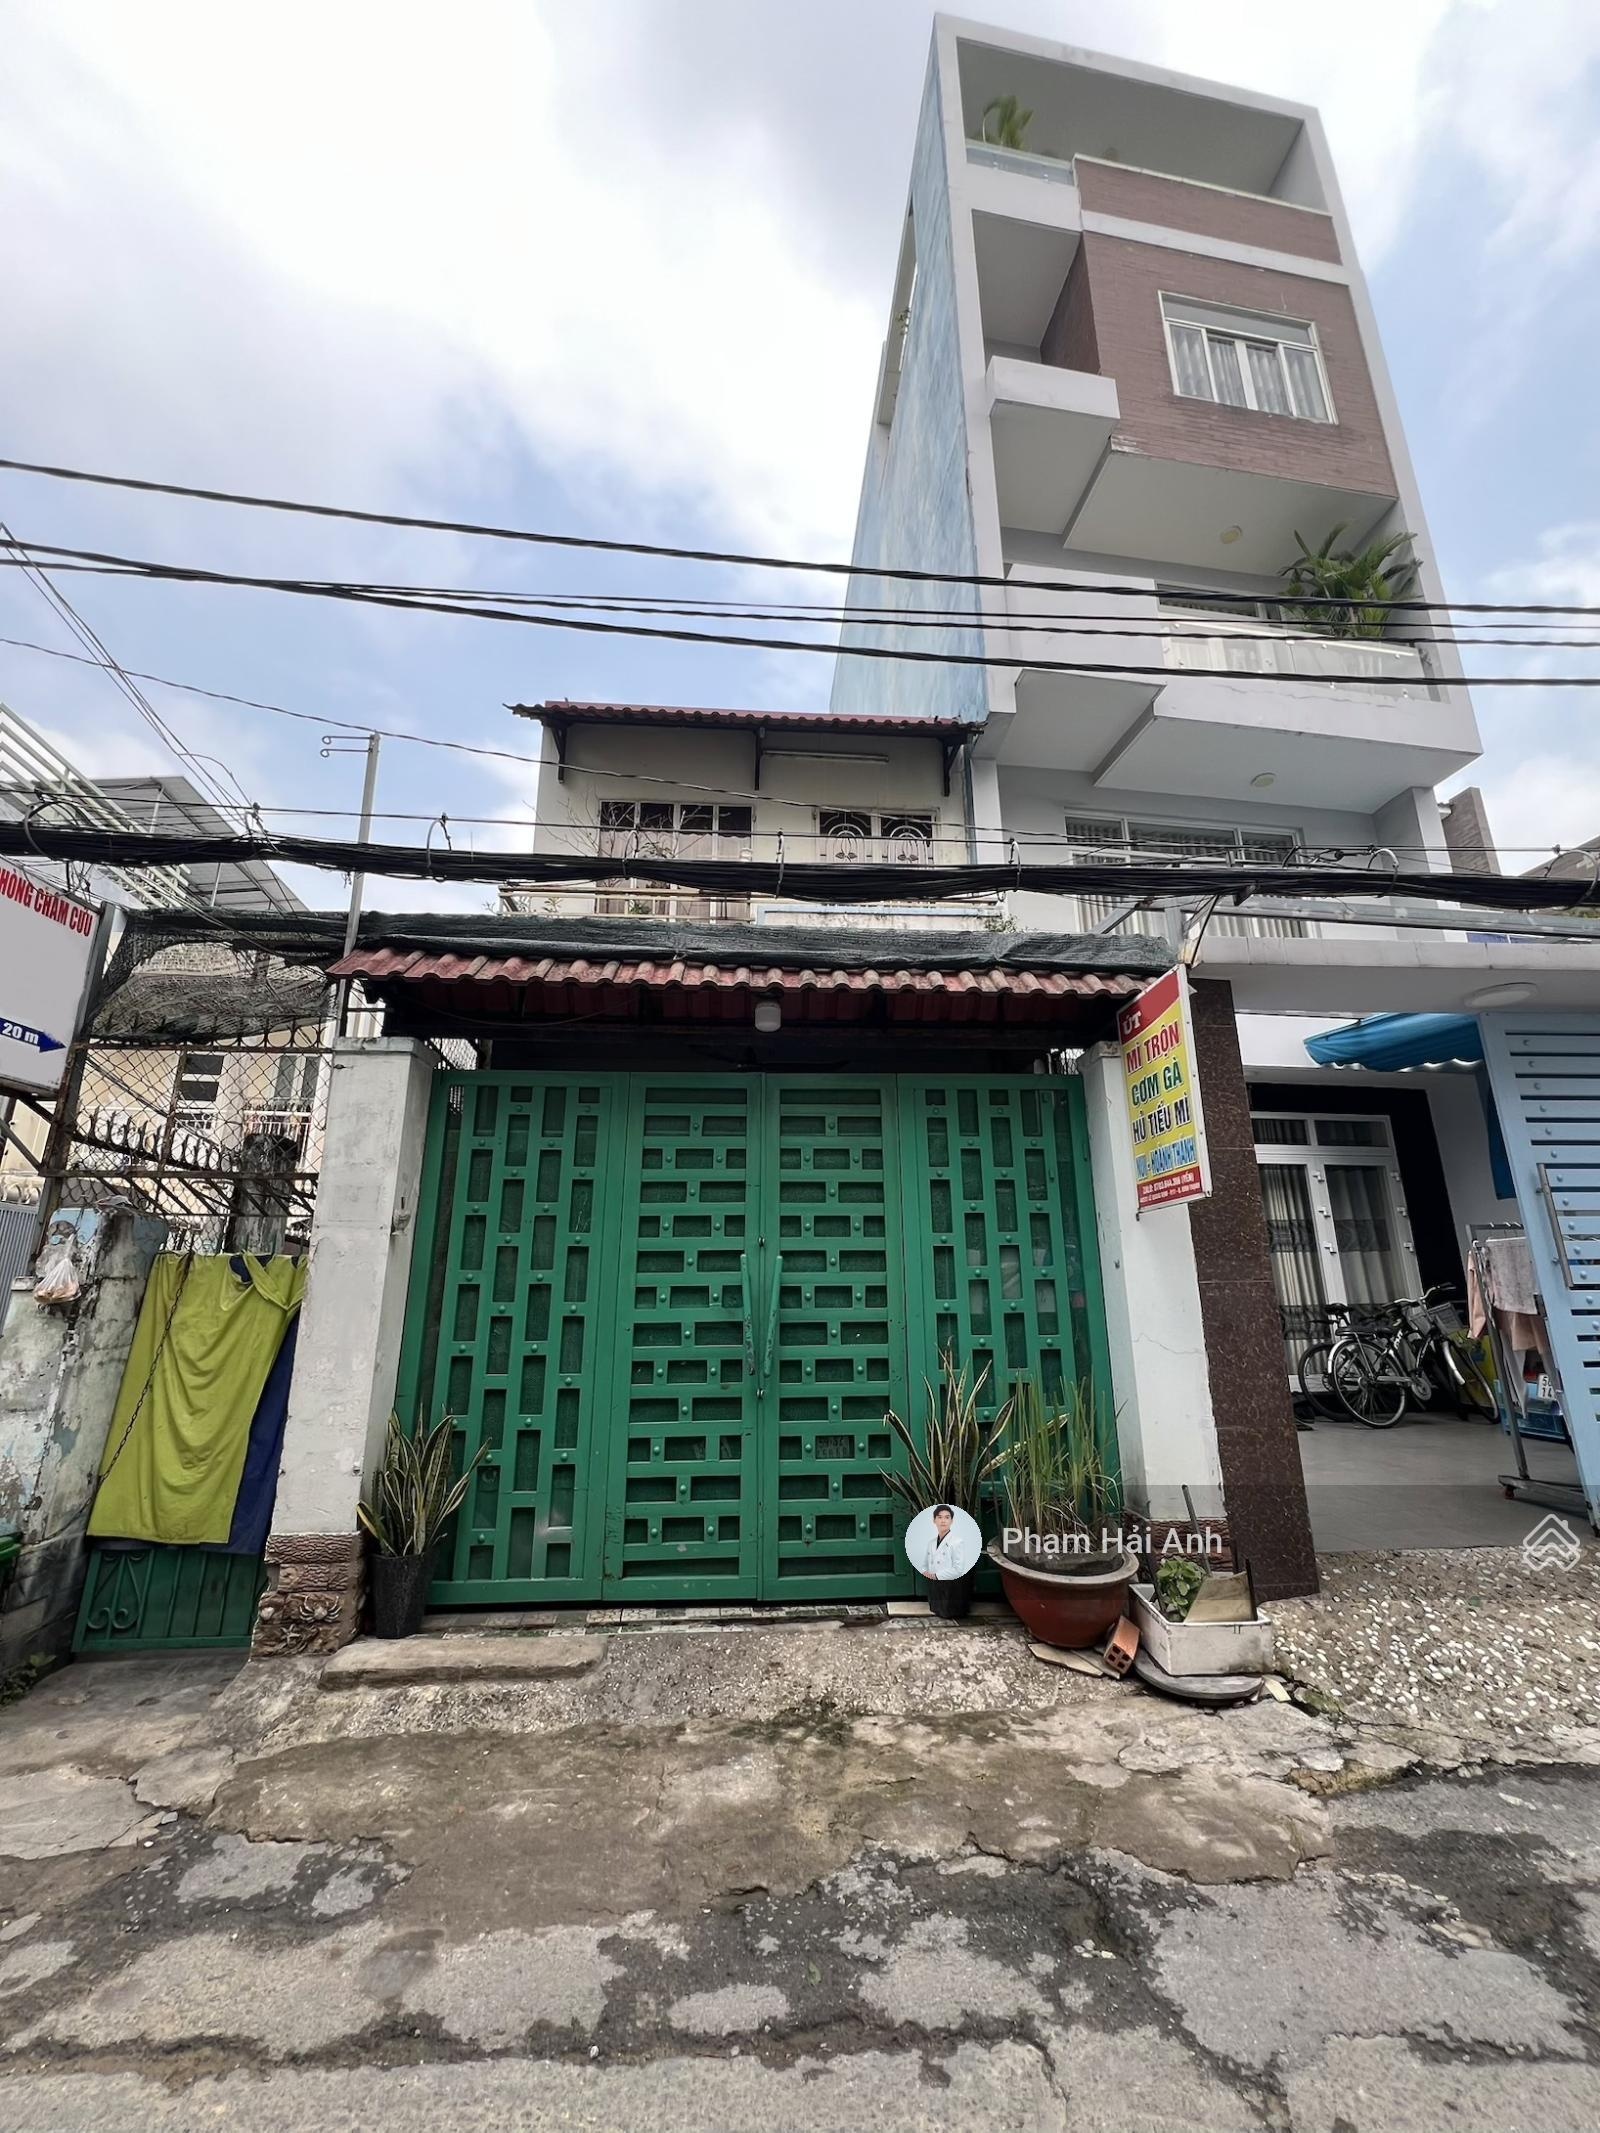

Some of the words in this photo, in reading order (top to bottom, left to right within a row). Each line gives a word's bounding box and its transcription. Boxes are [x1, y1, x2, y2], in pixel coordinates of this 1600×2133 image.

[0, 867, 33, 908] HÒNG
[2, 1022, 23, 1039] 20
[24, 1031, 39, 1044] m
[1123, 1011, 1142, 1035] ÚT
[1126, 1042, 1142, 1074] MÌ
[1144, 1021, 1180, 1062] TRỘN
[1132, 1073, 1159, 1106] CƠM
[1164, 1057, 1182, 1090] GÀ
[1132, 1111, 1147, 1143] HỦ
[1174, 1092, 1190, 1125] MÌ
